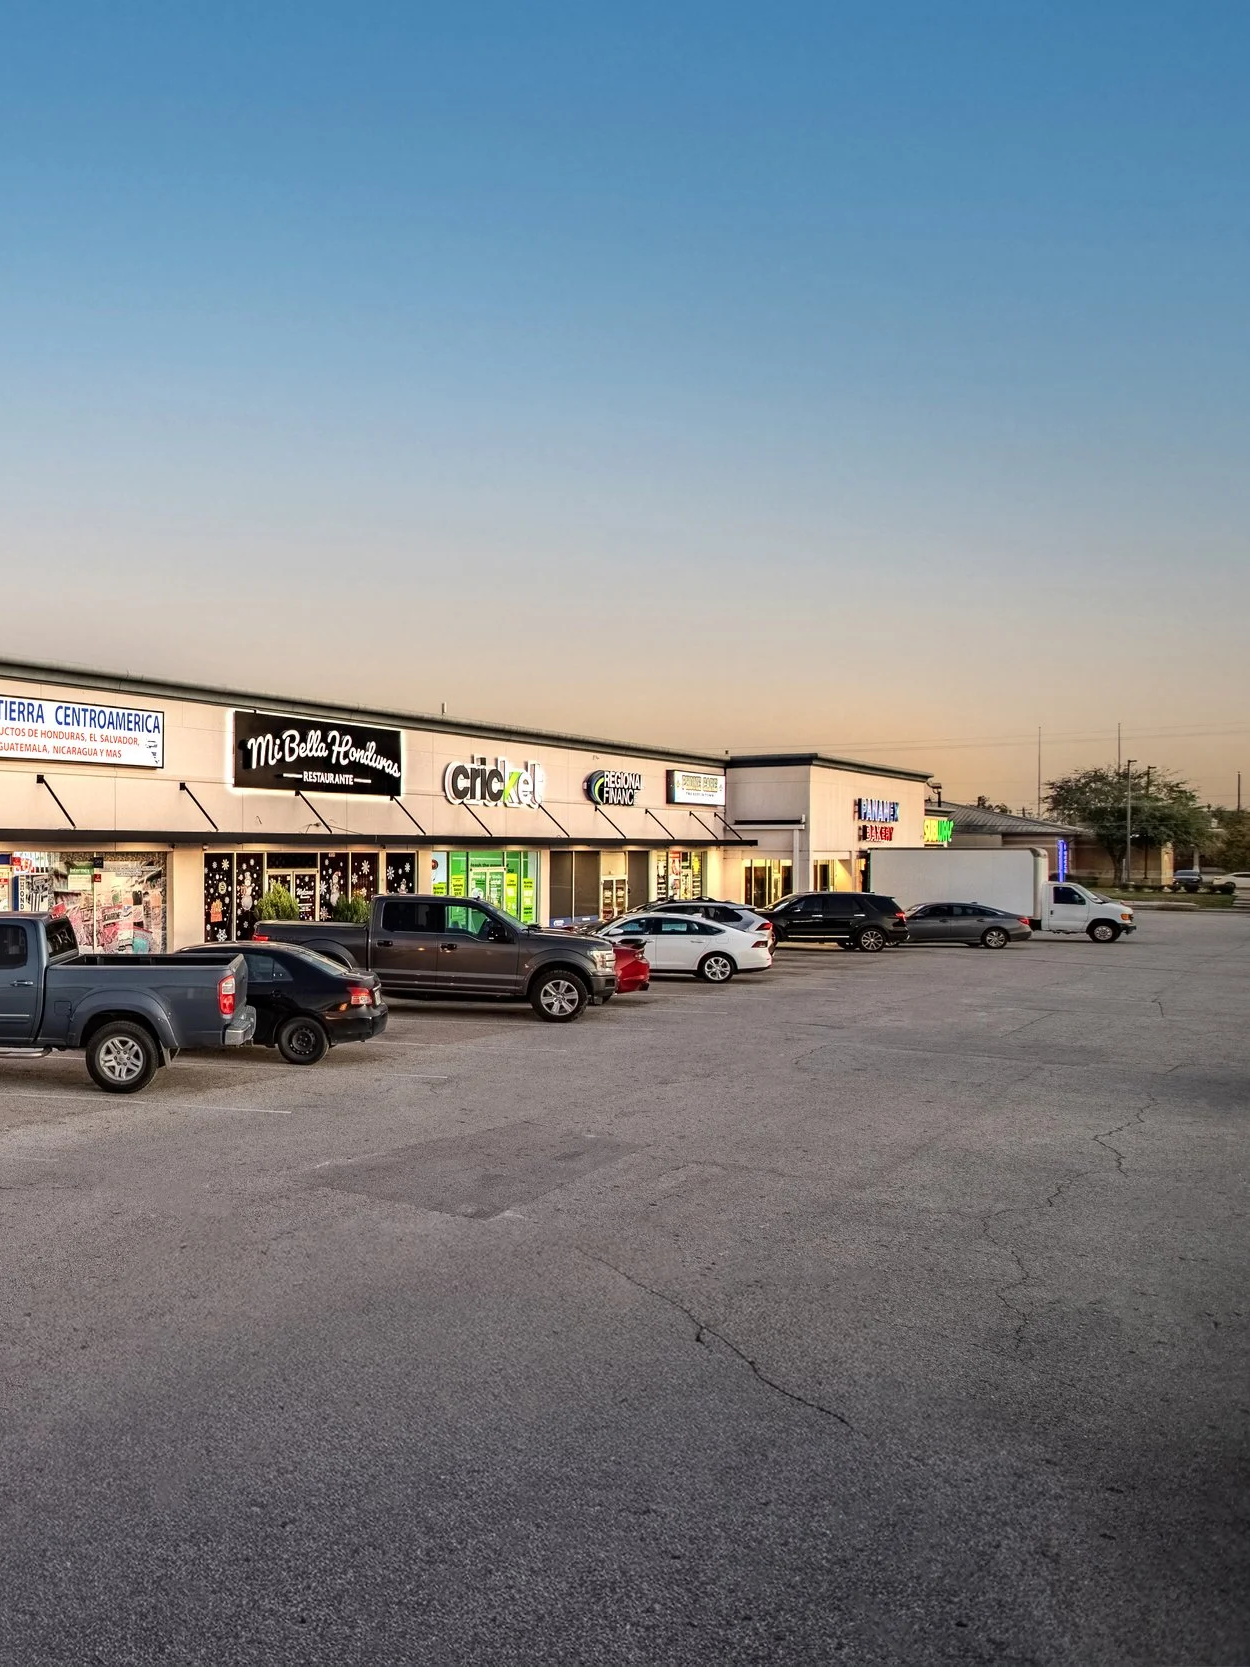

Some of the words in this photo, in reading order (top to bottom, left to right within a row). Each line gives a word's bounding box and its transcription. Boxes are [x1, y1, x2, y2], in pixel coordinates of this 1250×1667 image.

[54, 705, 161, 734] CENTROAMERICA
[27, 728, 39, 738] DE
[40, 729, 87, 743] HONDURAS,
[89, 733, 98, 742] EL
[100, 734, 140, 746] SALVADOR,
[52, 745, 98, 757] NICARAGUA
[99, 748, 104, 757] Y
[105, 749, 122, 759] MAS
[247, 733, 282, 770] Mi
[282, 729, 329, 762] Bella
[327, 730, 401, 778] Honduras
[303, 771, 354, 785] RESTAURANTE
[446, 752, 543, 808] cricket
[604, 771, 643, 789] REGIONAL
[603, 787, 638, 805] FINANCE
[865, 826, 894, 841] BAKERY
